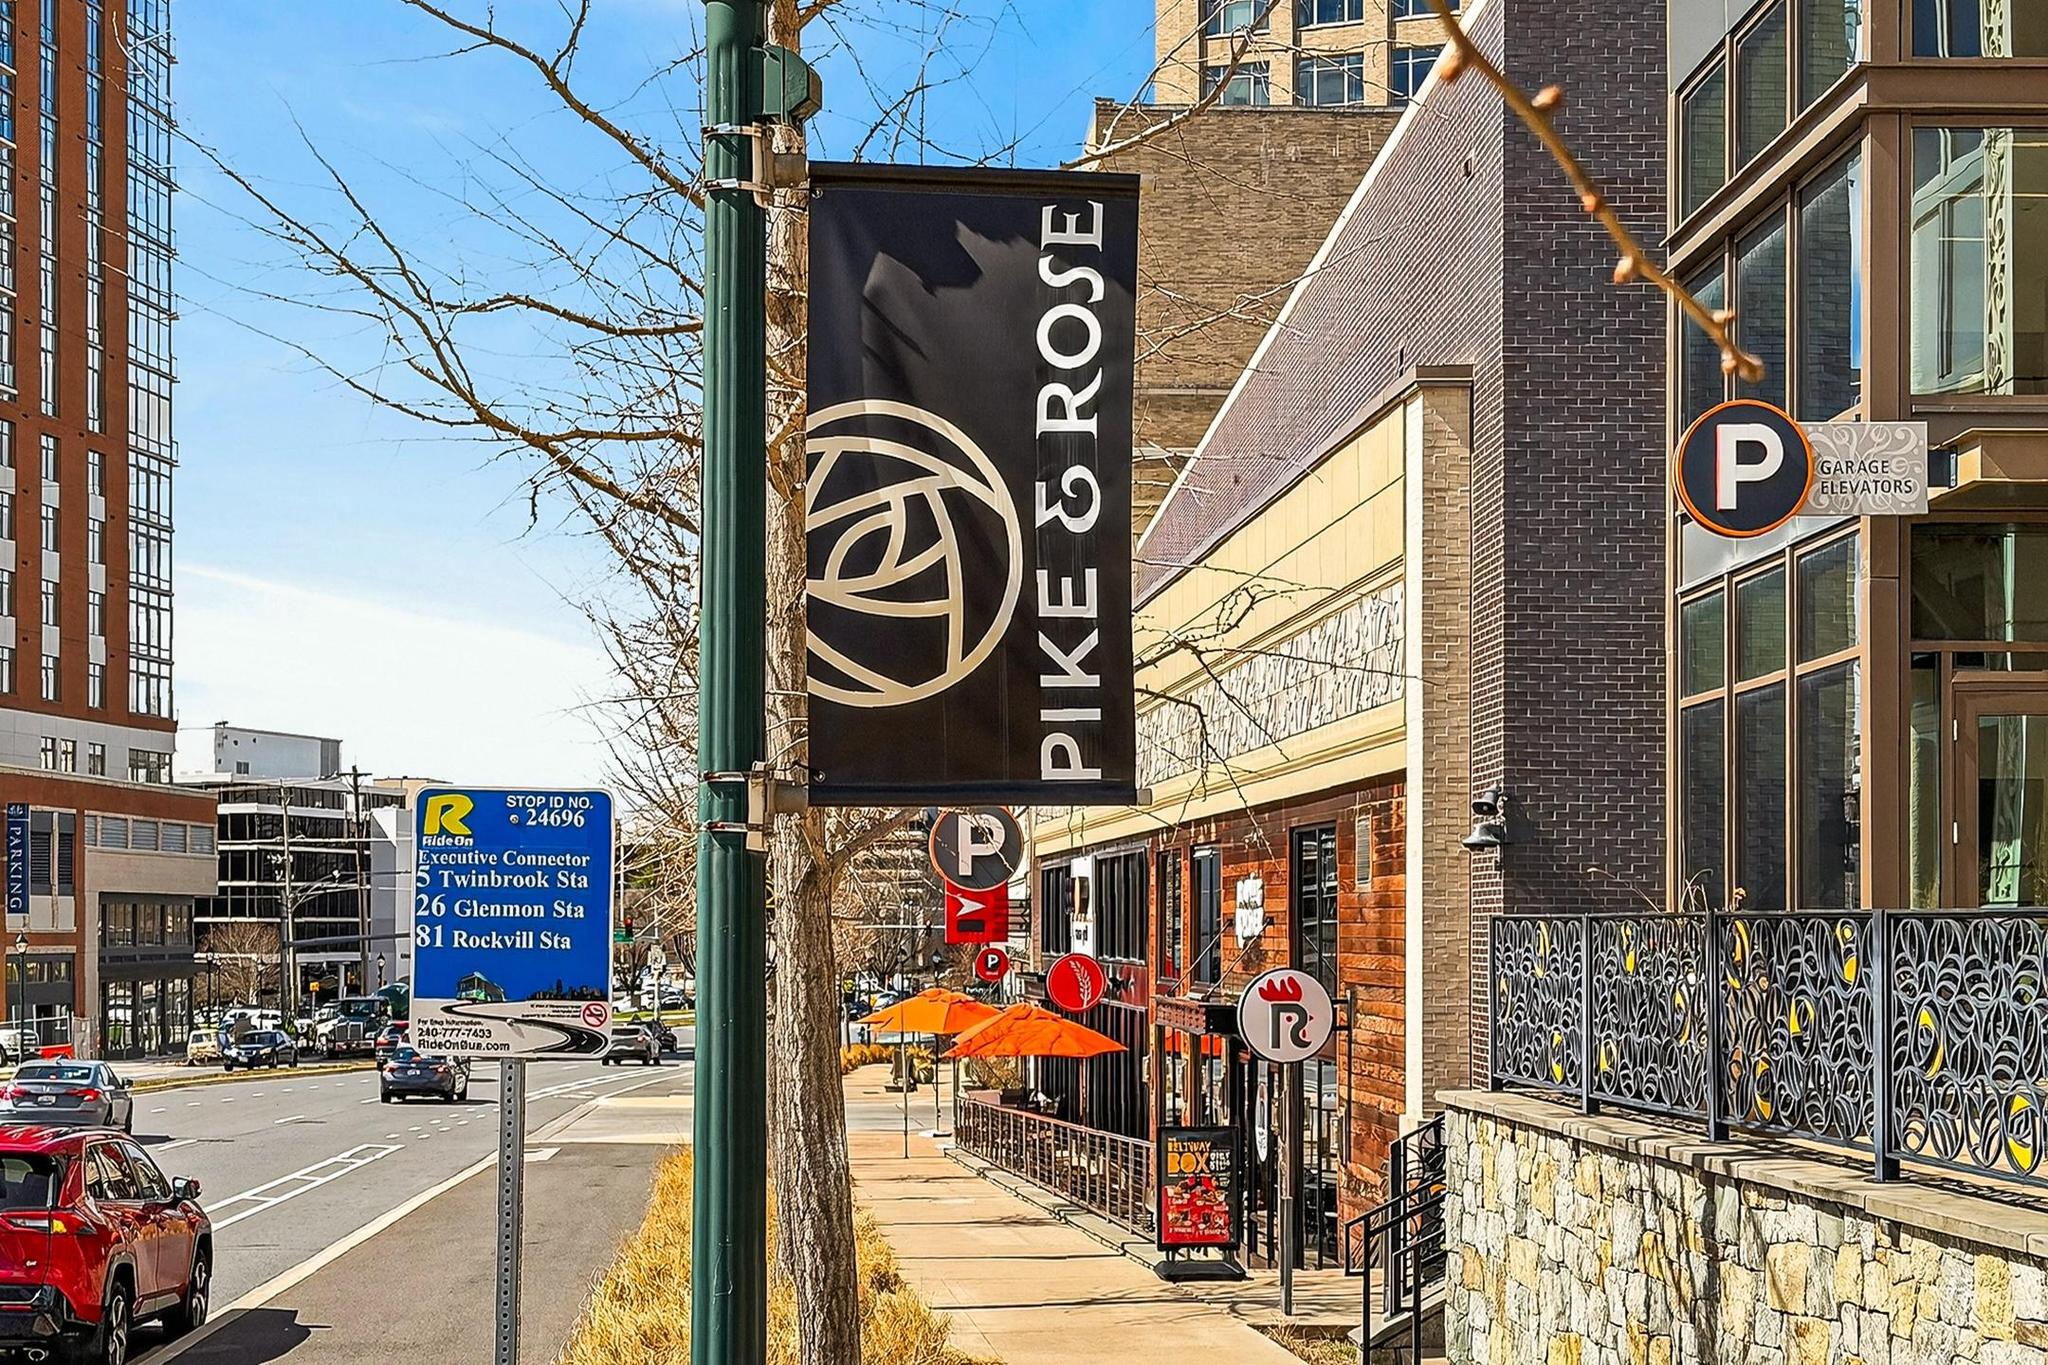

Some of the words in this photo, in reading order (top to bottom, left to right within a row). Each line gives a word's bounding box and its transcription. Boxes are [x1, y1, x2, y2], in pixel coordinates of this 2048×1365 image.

[1036, 200, 1104, 440] ROSE
[1716, 423, 1784, 511] P
[1820, 460, 1889, 475] GARAGE
[1036, 465, 1101, 533] &
[1820, 479, 1913, 495] ELEVATORS
[1036, 567, 1101, 780] PIKE
[506, 795, 546, 808] STOP
[549, 796, 564, 808] ID
[568, 796, 593, 810] NO.
[526, 808, 585, 828] 24696
[958, 813, 1005, 876] P
[9, 827, 23, 909] PARKING
[418, 849, 498, 865] Executive
[502, 850, 590, 867] Connector
[416, 864, 431, 888] 5
[438, 869, 549, 889] Twinbrook
[556, 870, 589, 889] Sta
[416, 893, 446, 917] 26
[454, 899, 545, 918] Glenmon
[552, 899, 585, 918] Sta
[416, 924, 444, 948] 81
[452, 929, 534, 949] Rockvill
[540, 930, 571, 950] Sta
[987, 954, 999, 968] P
[1167, 1152, 1210, 1174] BOX
